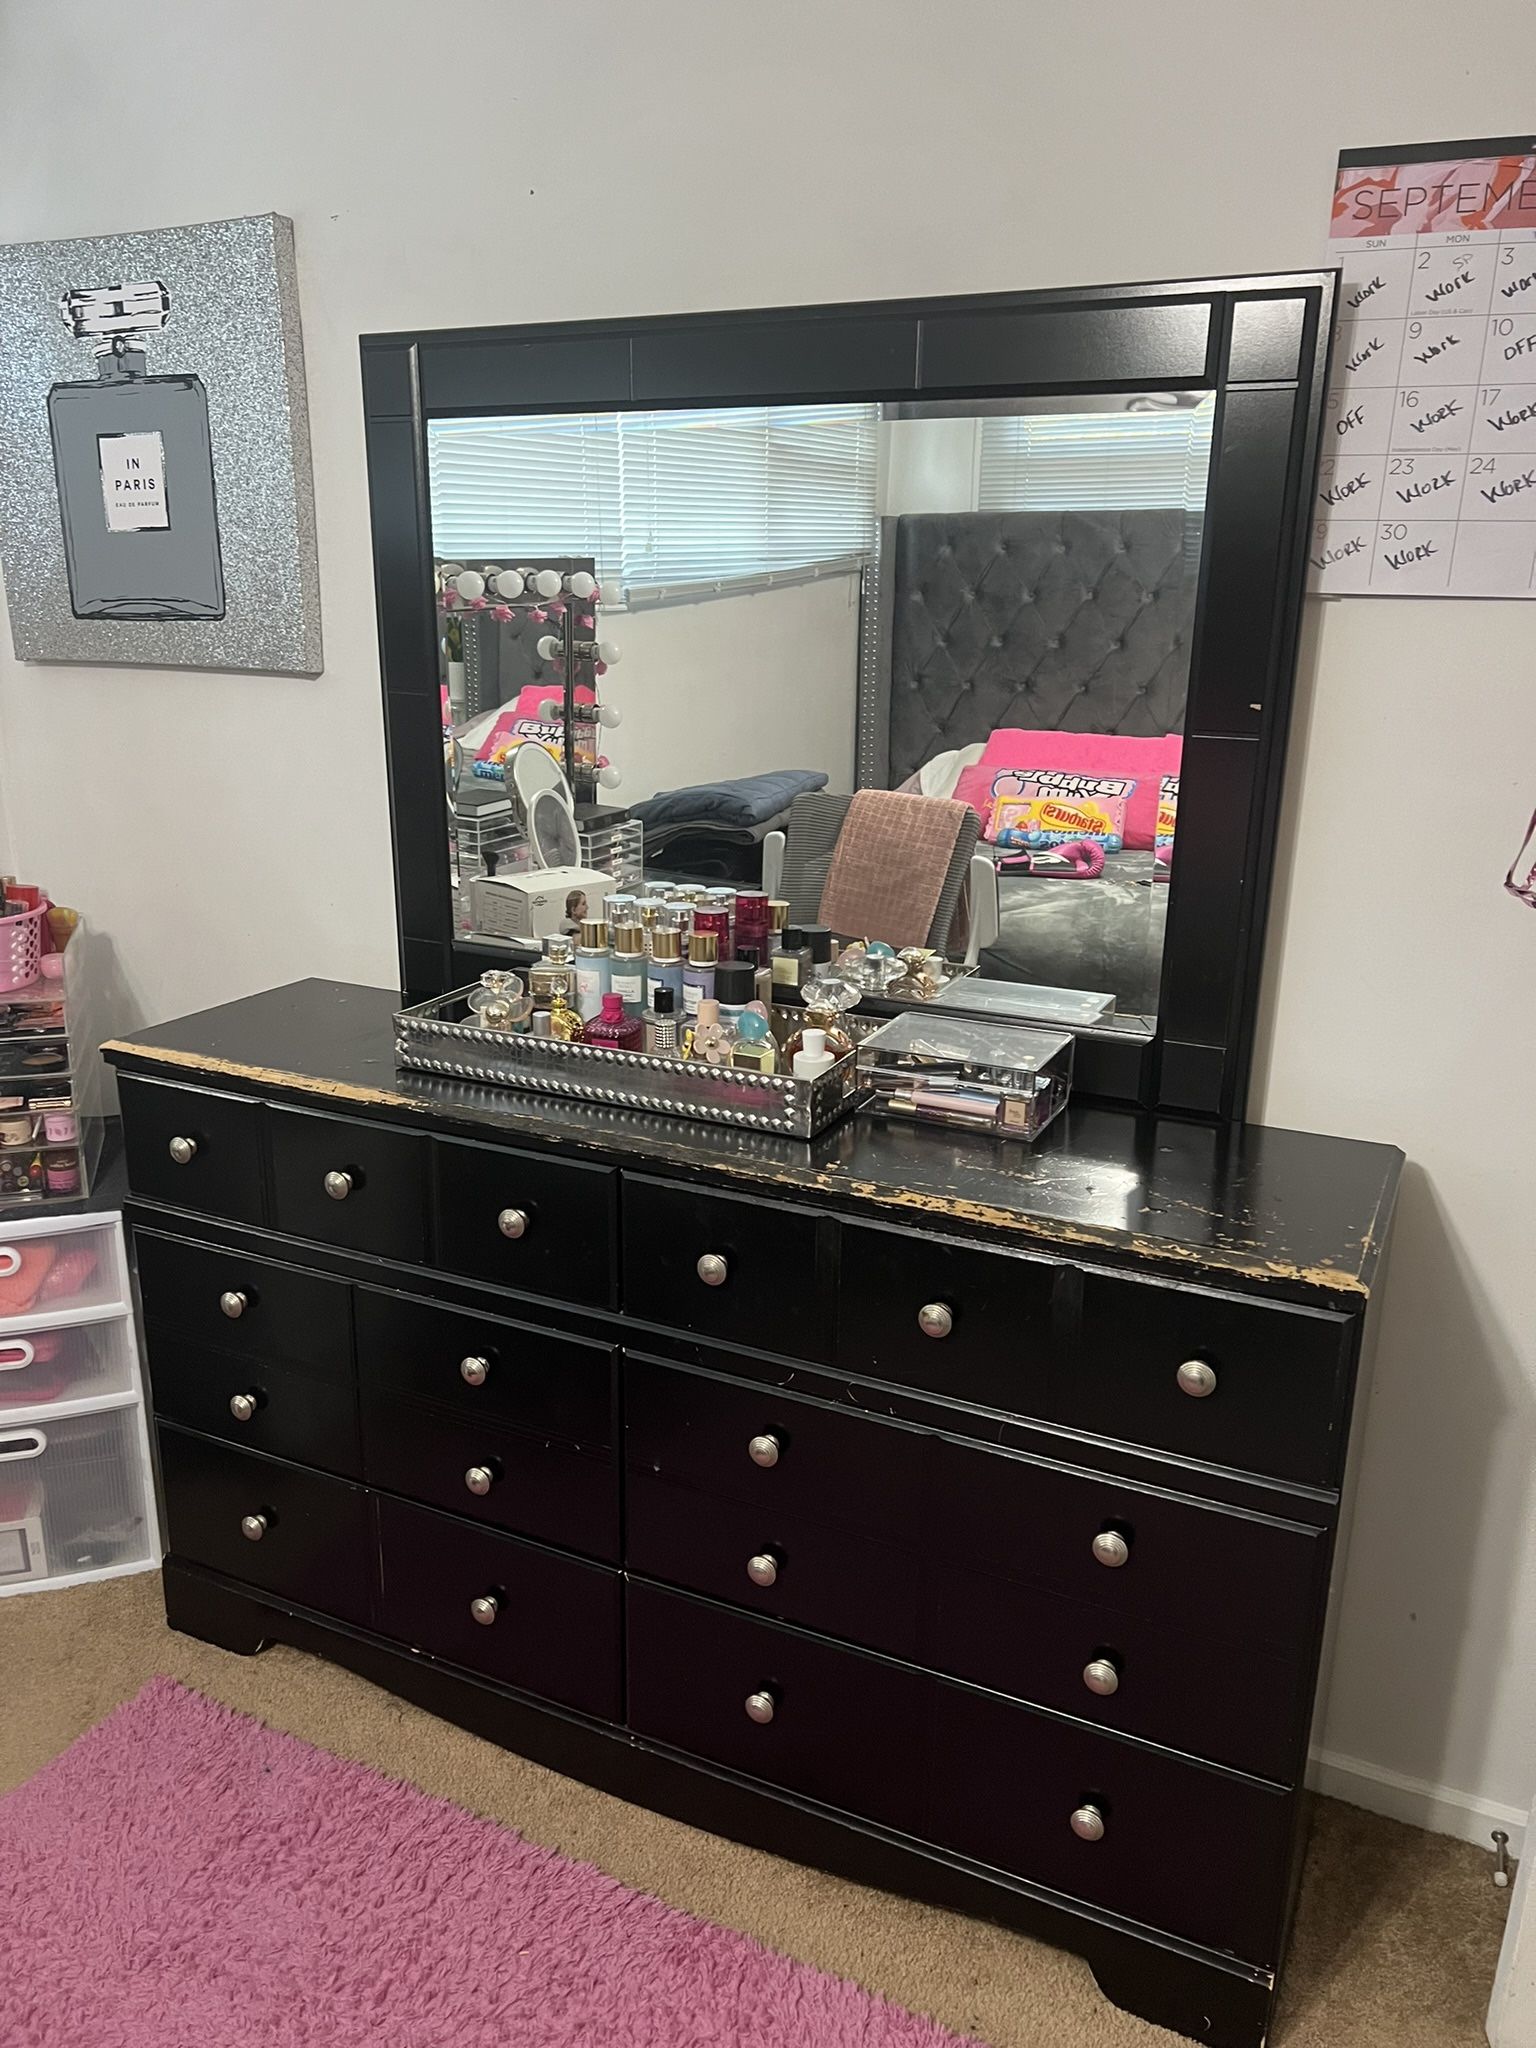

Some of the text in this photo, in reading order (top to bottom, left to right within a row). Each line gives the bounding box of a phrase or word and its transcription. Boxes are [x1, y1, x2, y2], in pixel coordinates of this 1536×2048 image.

[1366, 235, 1471, 248] SUN MON
[1417, 251, 1431, 270] 2
[1501, 247, 1515, 265] 3
[1409, 321, 1423, 340] 9
[1491, 318, 1514, 336] 10
[1399, 390, 1420, 408] 16
[1481, 388, 1502, 406] 17
[1336, 404, 1364, 436] OFF
[126, 458, 140, 469] IN
[1389, 458, 1415, 475] 23
[1469, 457, 1496, 475] 24
[115, 478, 156, 491] PARIS
[1380, 523, 1408, 541] 30
